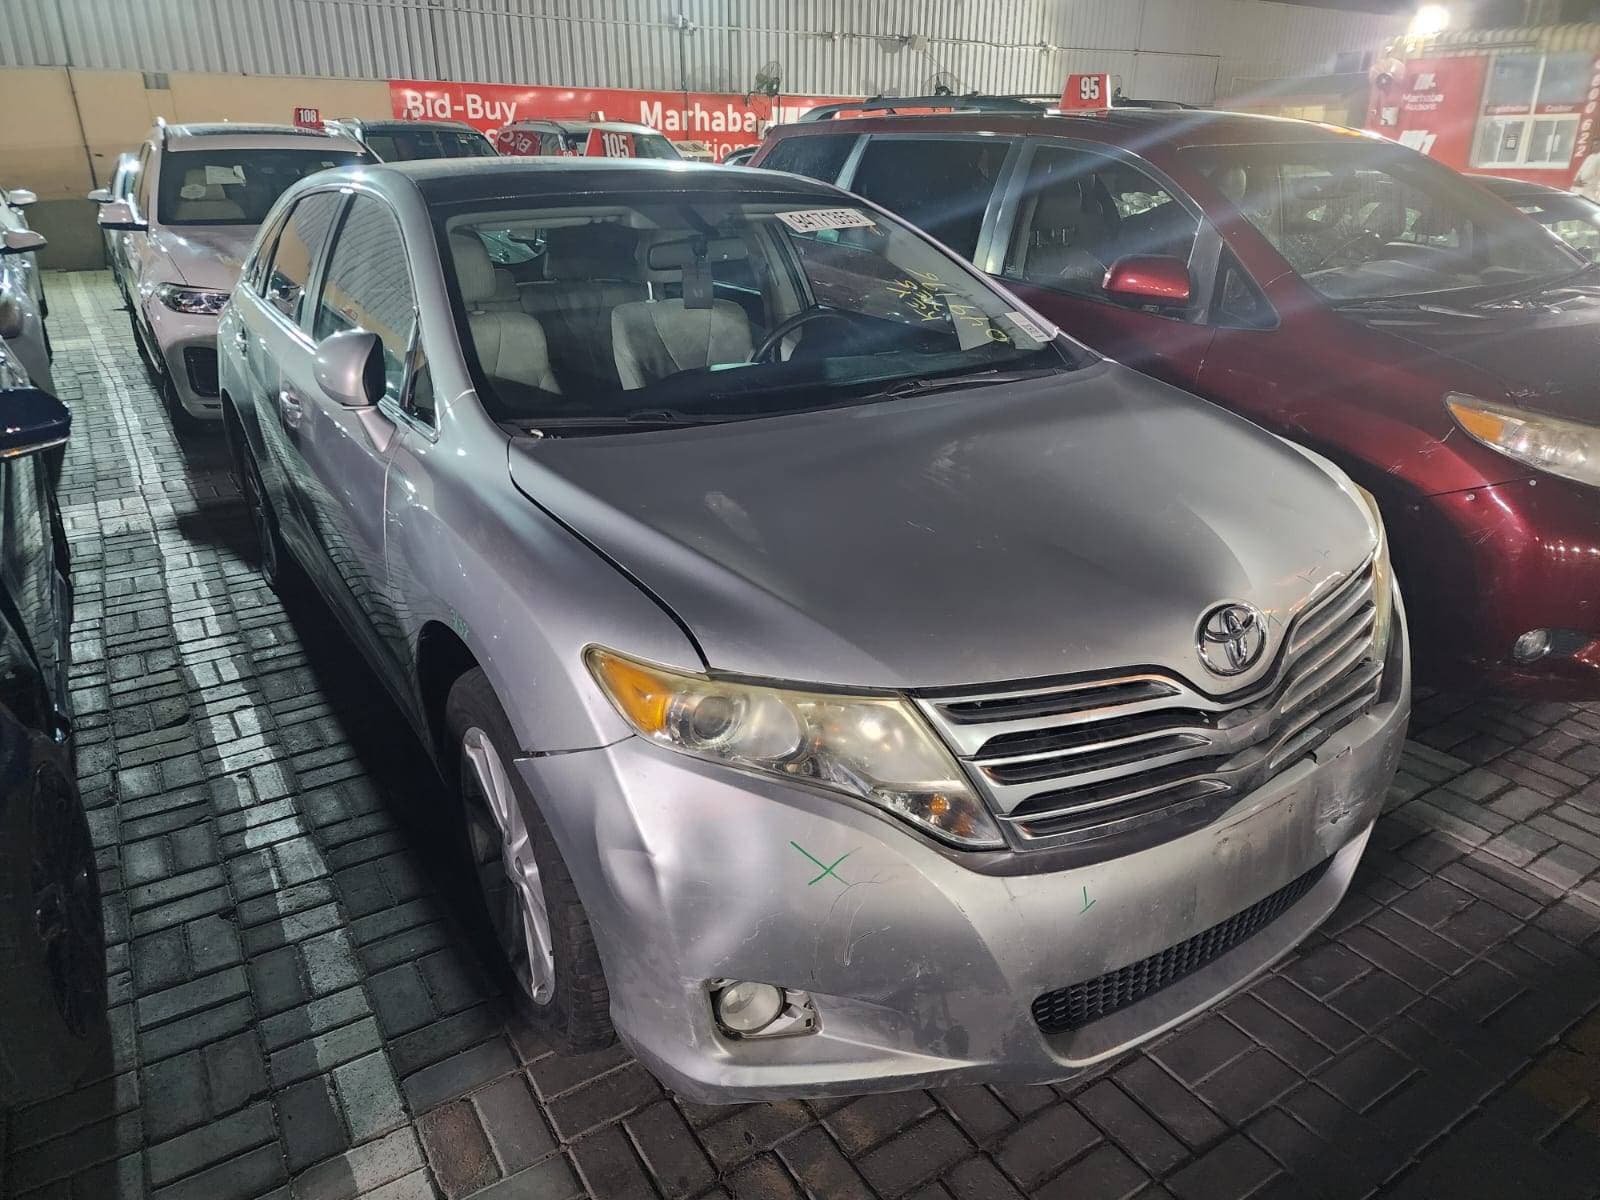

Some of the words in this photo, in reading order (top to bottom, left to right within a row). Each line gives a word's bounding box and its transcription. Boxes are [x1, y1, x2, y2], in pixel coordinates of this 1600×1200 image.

[1080, 76, 1100, 100] 95
[299, 109, 317, 123] 108
[404, 89, 517, 126] Bid-Buy
[640, 100, 756, 132] Marhaba
[602, 132, 630, 158] 105
